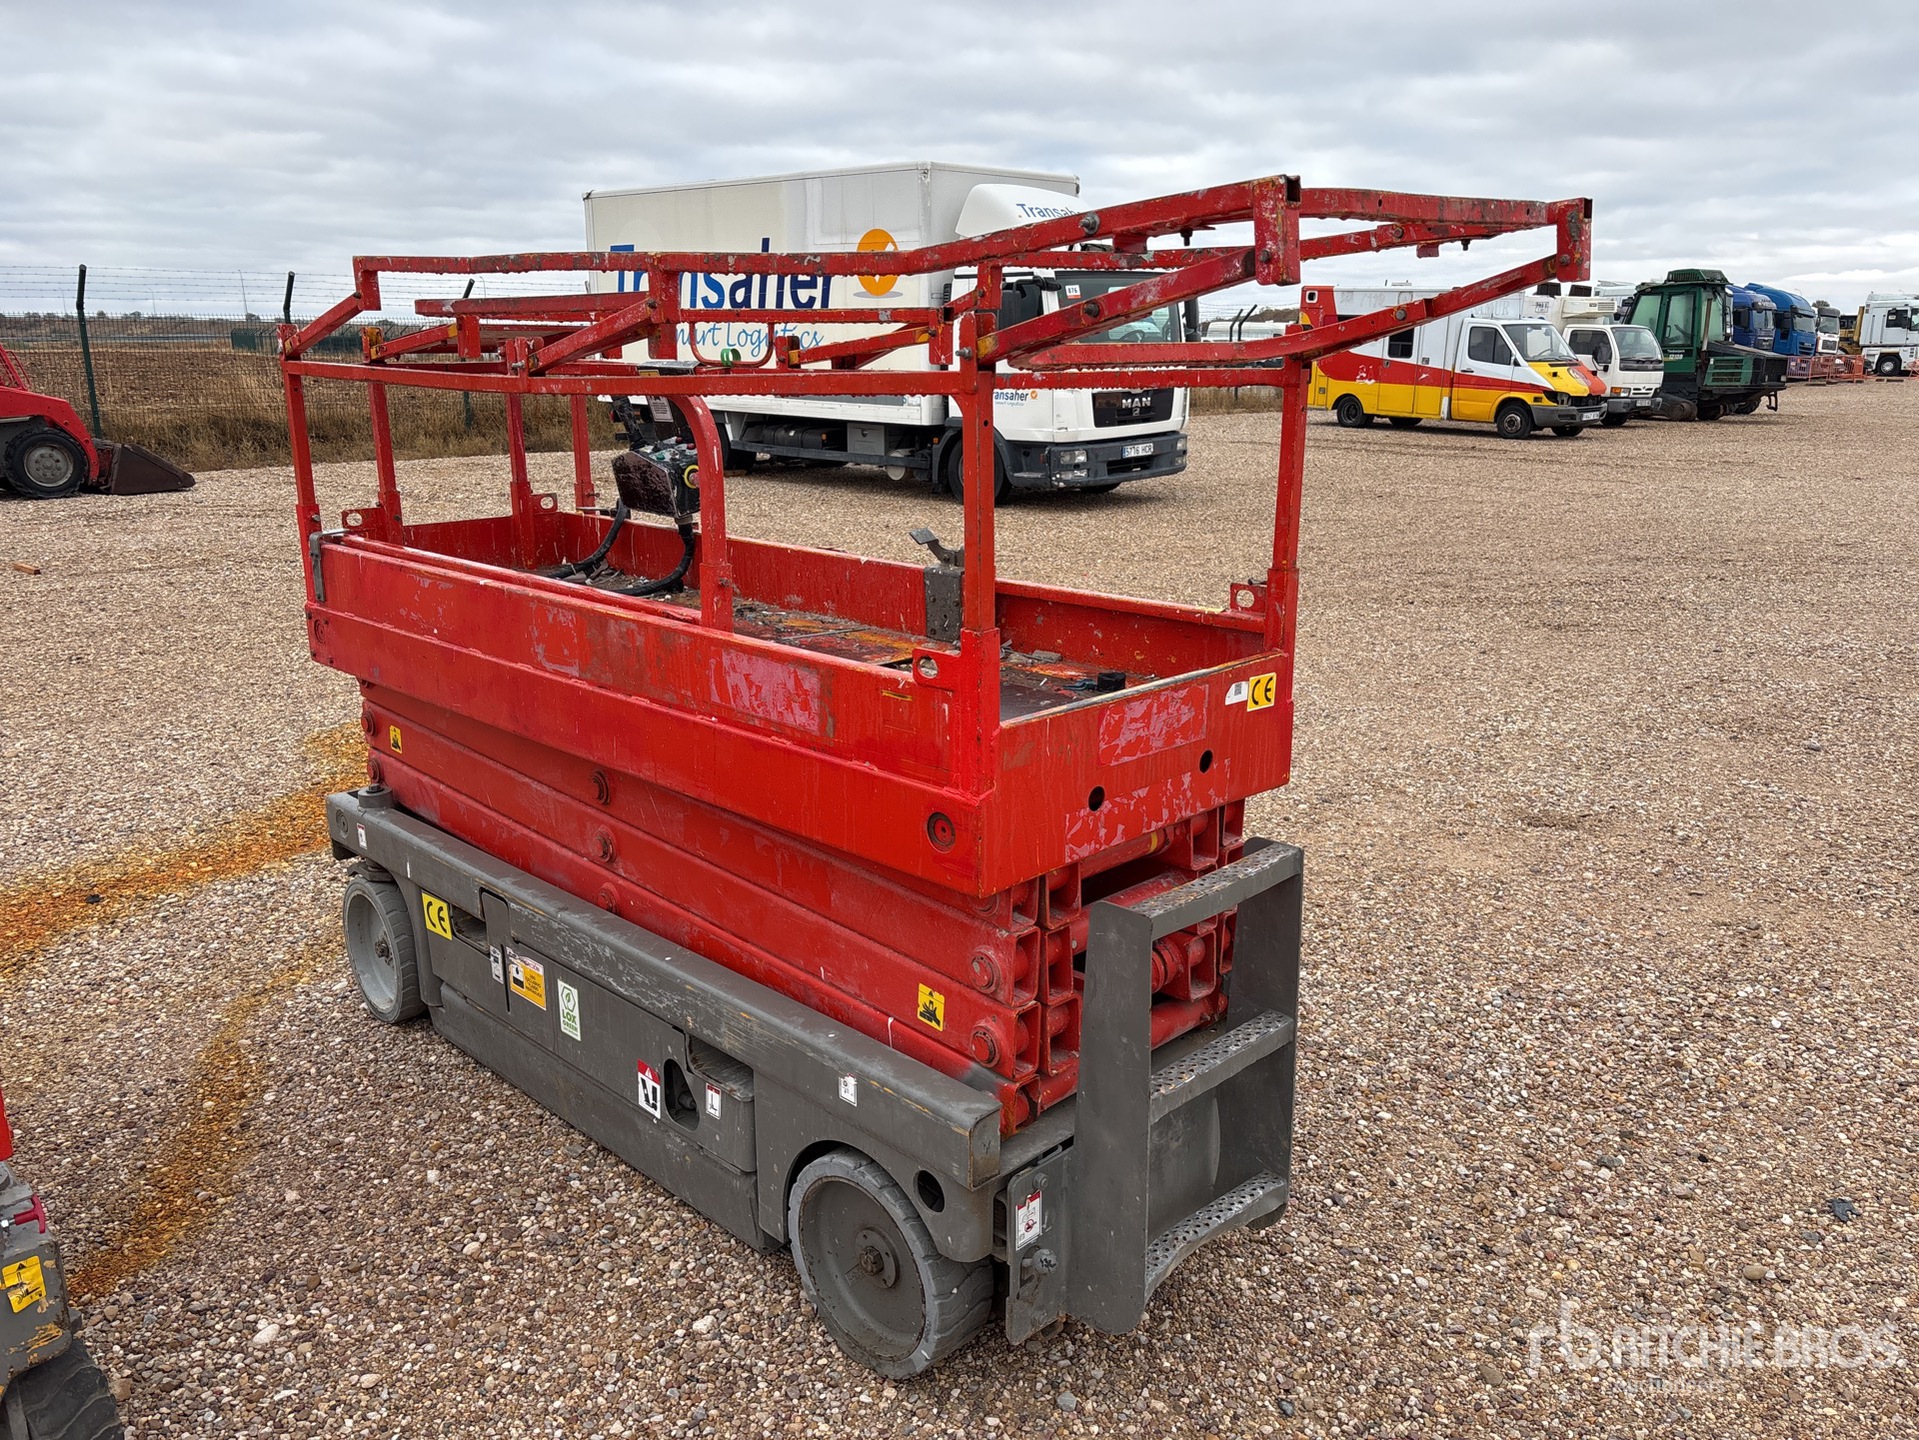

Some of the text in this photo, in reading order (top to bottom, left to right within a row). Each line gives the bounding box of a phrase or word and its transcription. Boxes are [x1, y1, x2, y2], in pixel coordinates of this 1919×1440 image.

[1121, 396, 1151, 409] MAN
[1140, 443, 1153, 455] HCR
[1251, 676, 1273, 706] CE
[426, 900, 448, 934] CE
[562, 1008, 577, 1026] LOX
